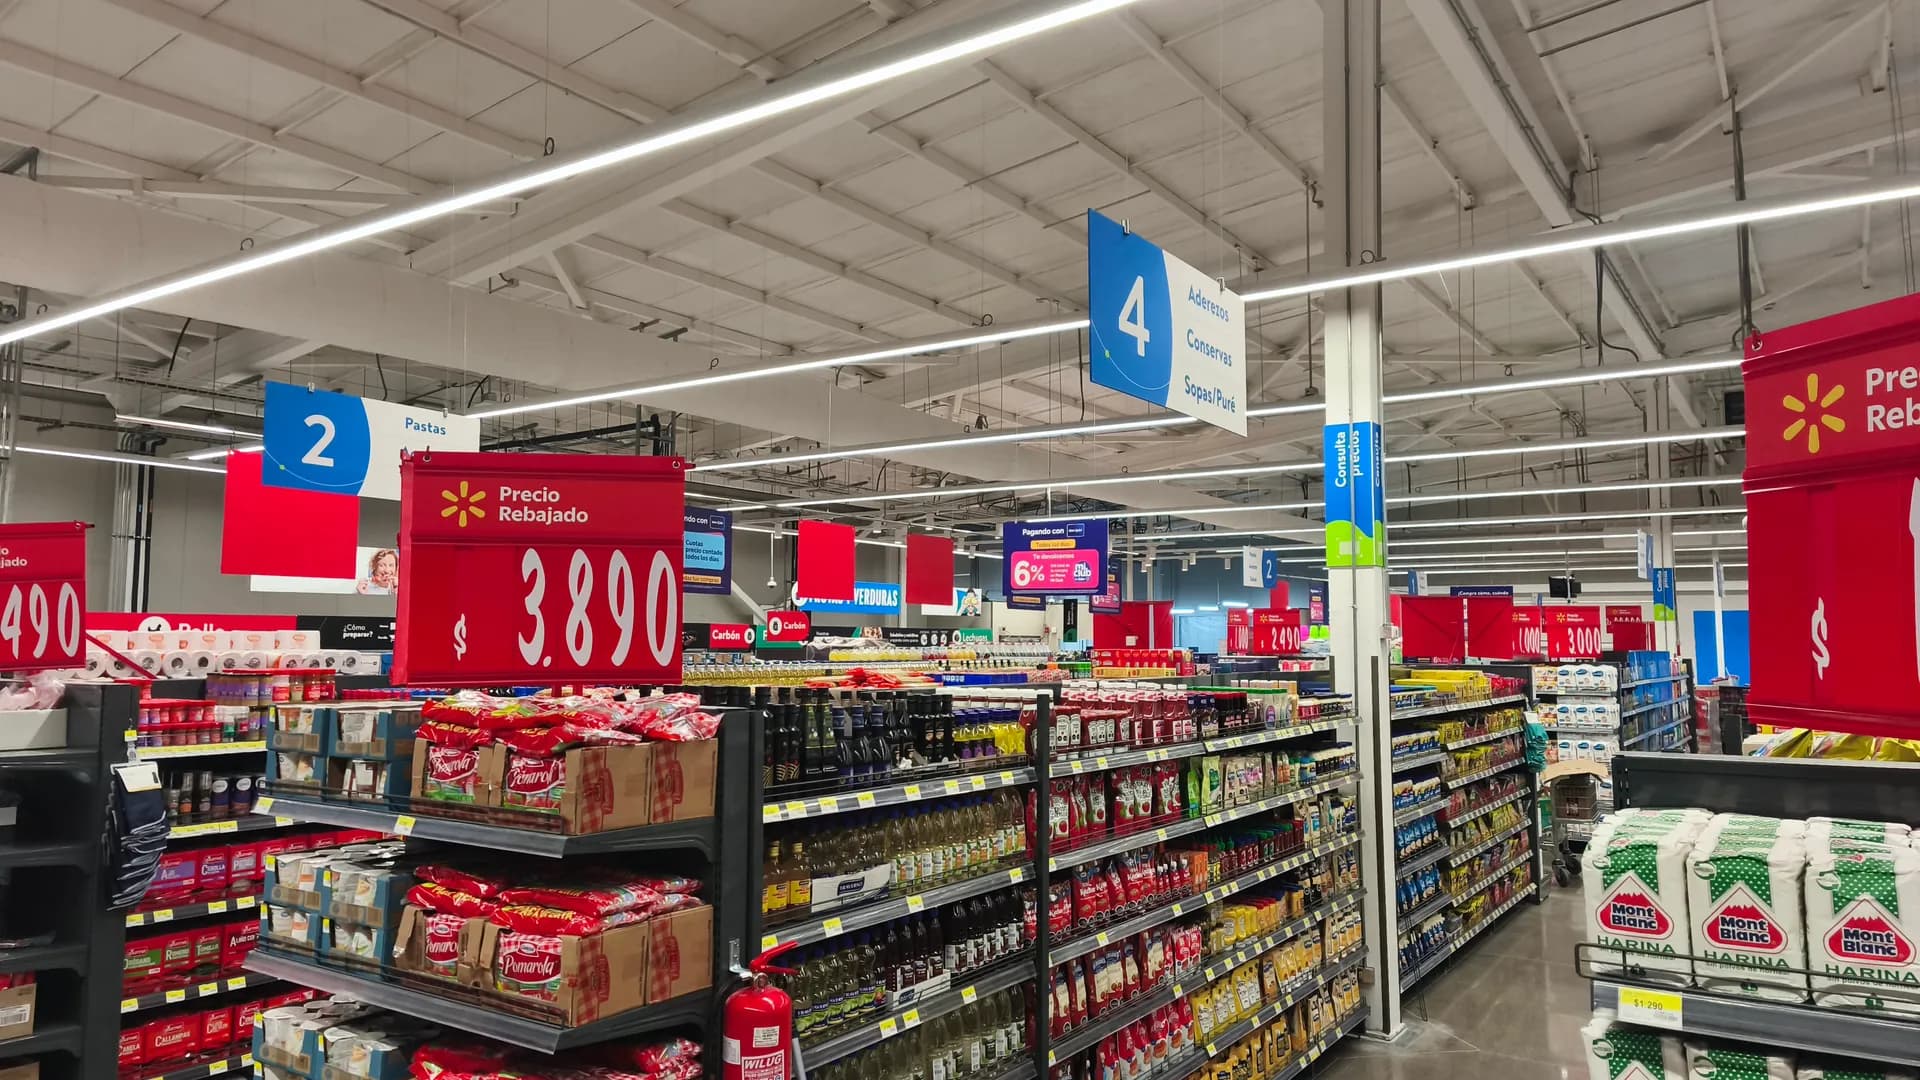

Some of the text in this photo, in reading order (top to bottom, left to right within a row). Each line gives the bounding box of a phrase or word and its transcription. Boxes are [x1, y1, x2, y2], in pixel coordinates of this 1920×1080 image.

[1188, 284, 1229, 322] Aderezos
[1118, 274, 1151, 358] 4
[1186, 328, 1232, 367] Conservas
[1184, 374, 1236, 414] Sopas/Puré
[405, 416, 447, 435] Pastas
[301, 413, 336, 468] 2
[1334, 431, 1347, 488] Consulta
[1347, 430, 1364, 477] precios
[499, 486, 560, 502] Precio
[499, 505, 589, 525] Rebajado
[1022, 528, 1051, 537] Pagando
[1266, 559, 1272, 579] 2
[518, 547, 678, 668] 3.890
[855, 588, 898, 607] VERDURAS
[712, 629, 740, 640] Carbón
[783, 621, 806, 630] Carbón
[453, 613, 467, 661] $
[1811, 597, 1830, 680] $
[1611, 903, 1655, 918] Mont
[1611, 914, 1657, 929] Blanc
[1720, 916, 1768, 931] Mont
[1597, 935, 1676, 955] HARINA
[1720, 928, 1769, 943] Blanc
[1843, 928, 1894, 943] Mont
[1843, 940, 1897, 956] Blanc
[504, 954, 555, 976] Pomarola
[1704, 950, 1790, 969] HARINA
[1825, 963, 1920, 984] HARINA
[744, 1054, 782, 1069] WILUG
